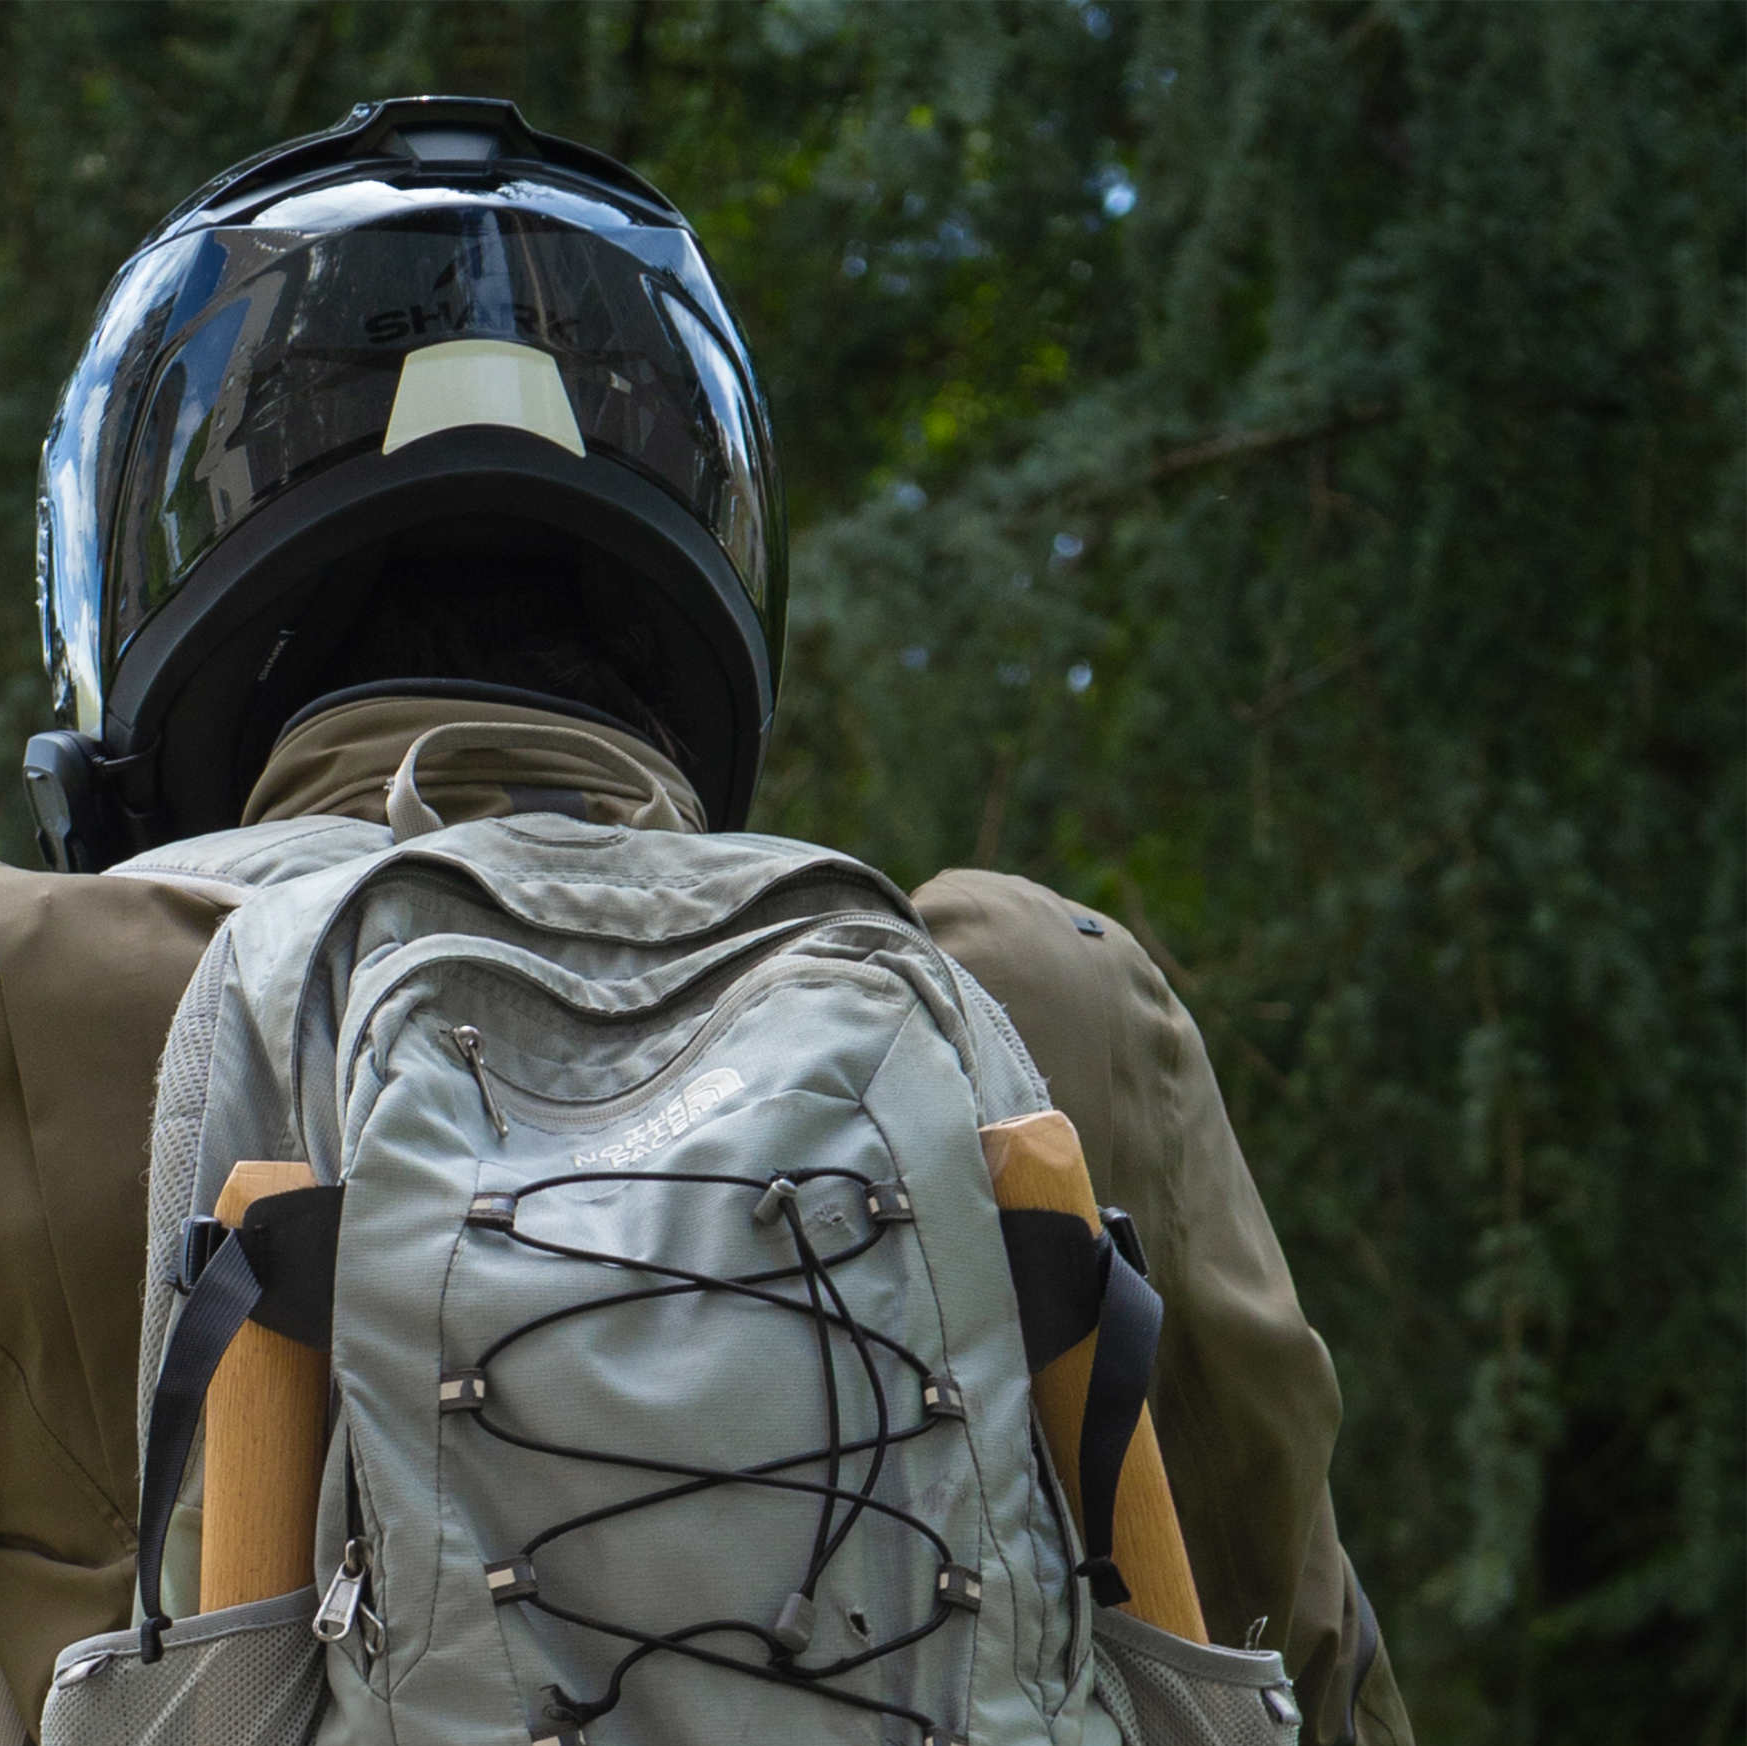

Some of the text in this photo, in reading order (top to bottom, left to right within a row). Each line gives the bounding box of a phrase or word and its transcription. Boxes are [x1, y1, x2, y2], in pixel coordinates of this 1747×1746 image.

[363, 302, 580, 346] SHARK
[574, 1104, 688, 1168] NORTH
[622, 1094, 684, 1138] THE
[611, 1119, 690, 1169] FACE
